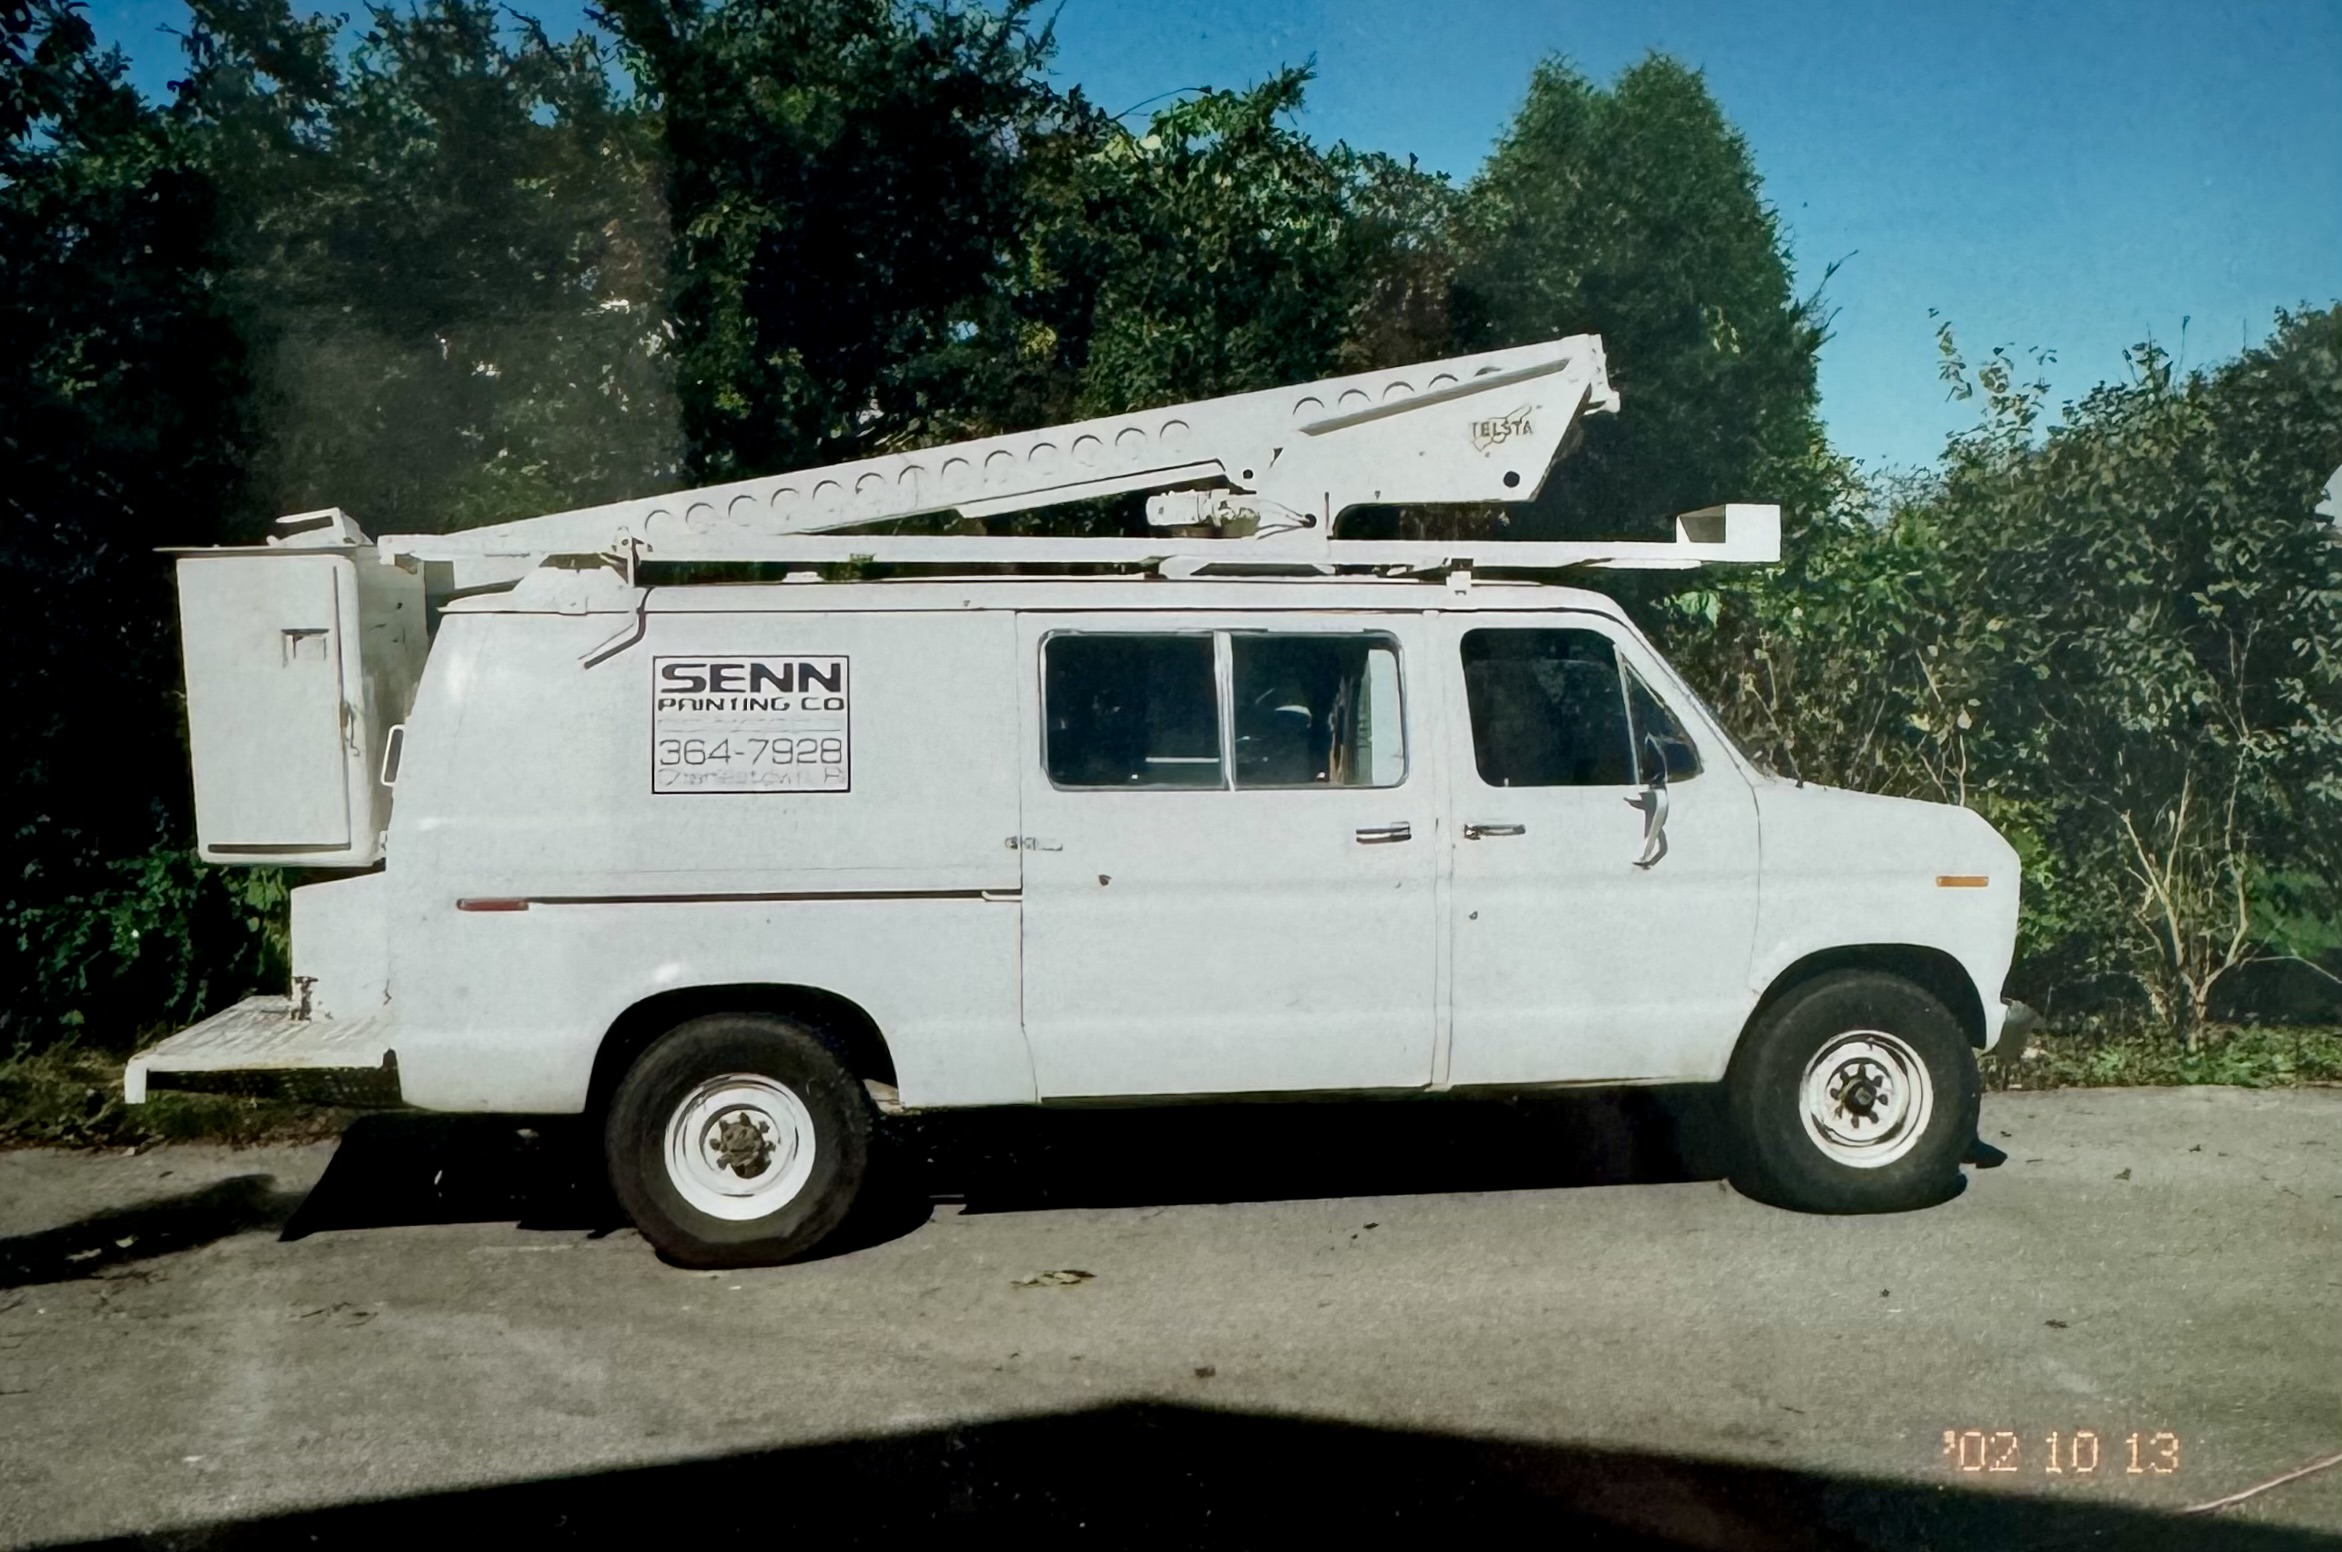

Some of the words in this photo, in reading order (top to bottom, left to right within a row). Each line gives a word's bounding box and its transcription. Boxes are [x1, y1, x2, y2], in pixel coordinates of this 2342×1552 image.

[1470, 420, 1534, 438] TELSTA
[660, 663, 842, 693] SENN
[801, 697, 845, 711] CO
[659, 738, 843, 766] 364-7928
